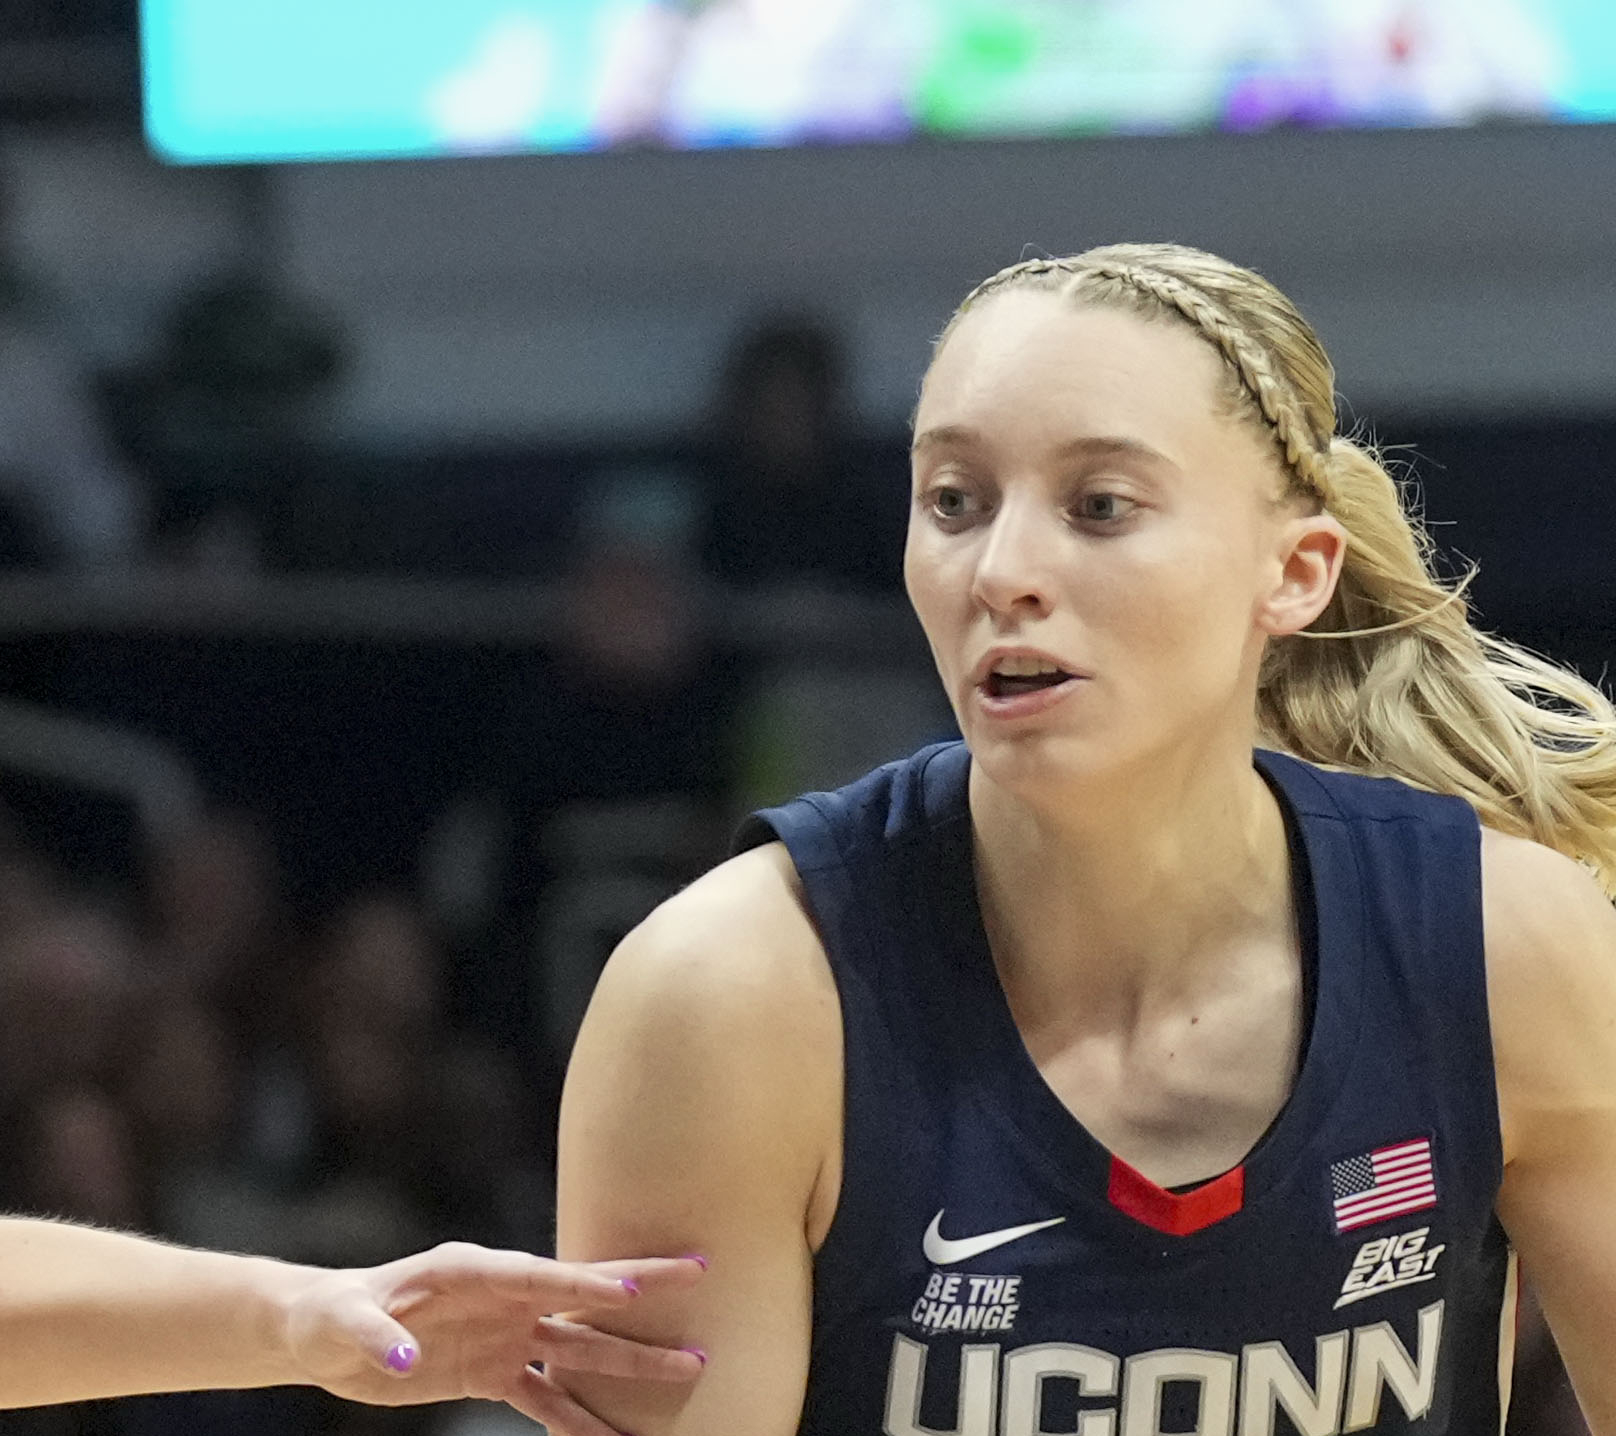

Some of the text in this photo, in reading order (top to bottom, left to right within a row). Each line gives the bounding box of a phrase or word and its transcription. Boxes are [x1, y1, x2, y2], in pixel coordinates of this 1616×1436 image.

[1354, 1227, 1430, 1268] BIG
[1341, 1243, 1445, 1293] EAST
[925, 1273, 1020, 1303] BE THE
[911, 1298, 1020, 1330] CHANGE
